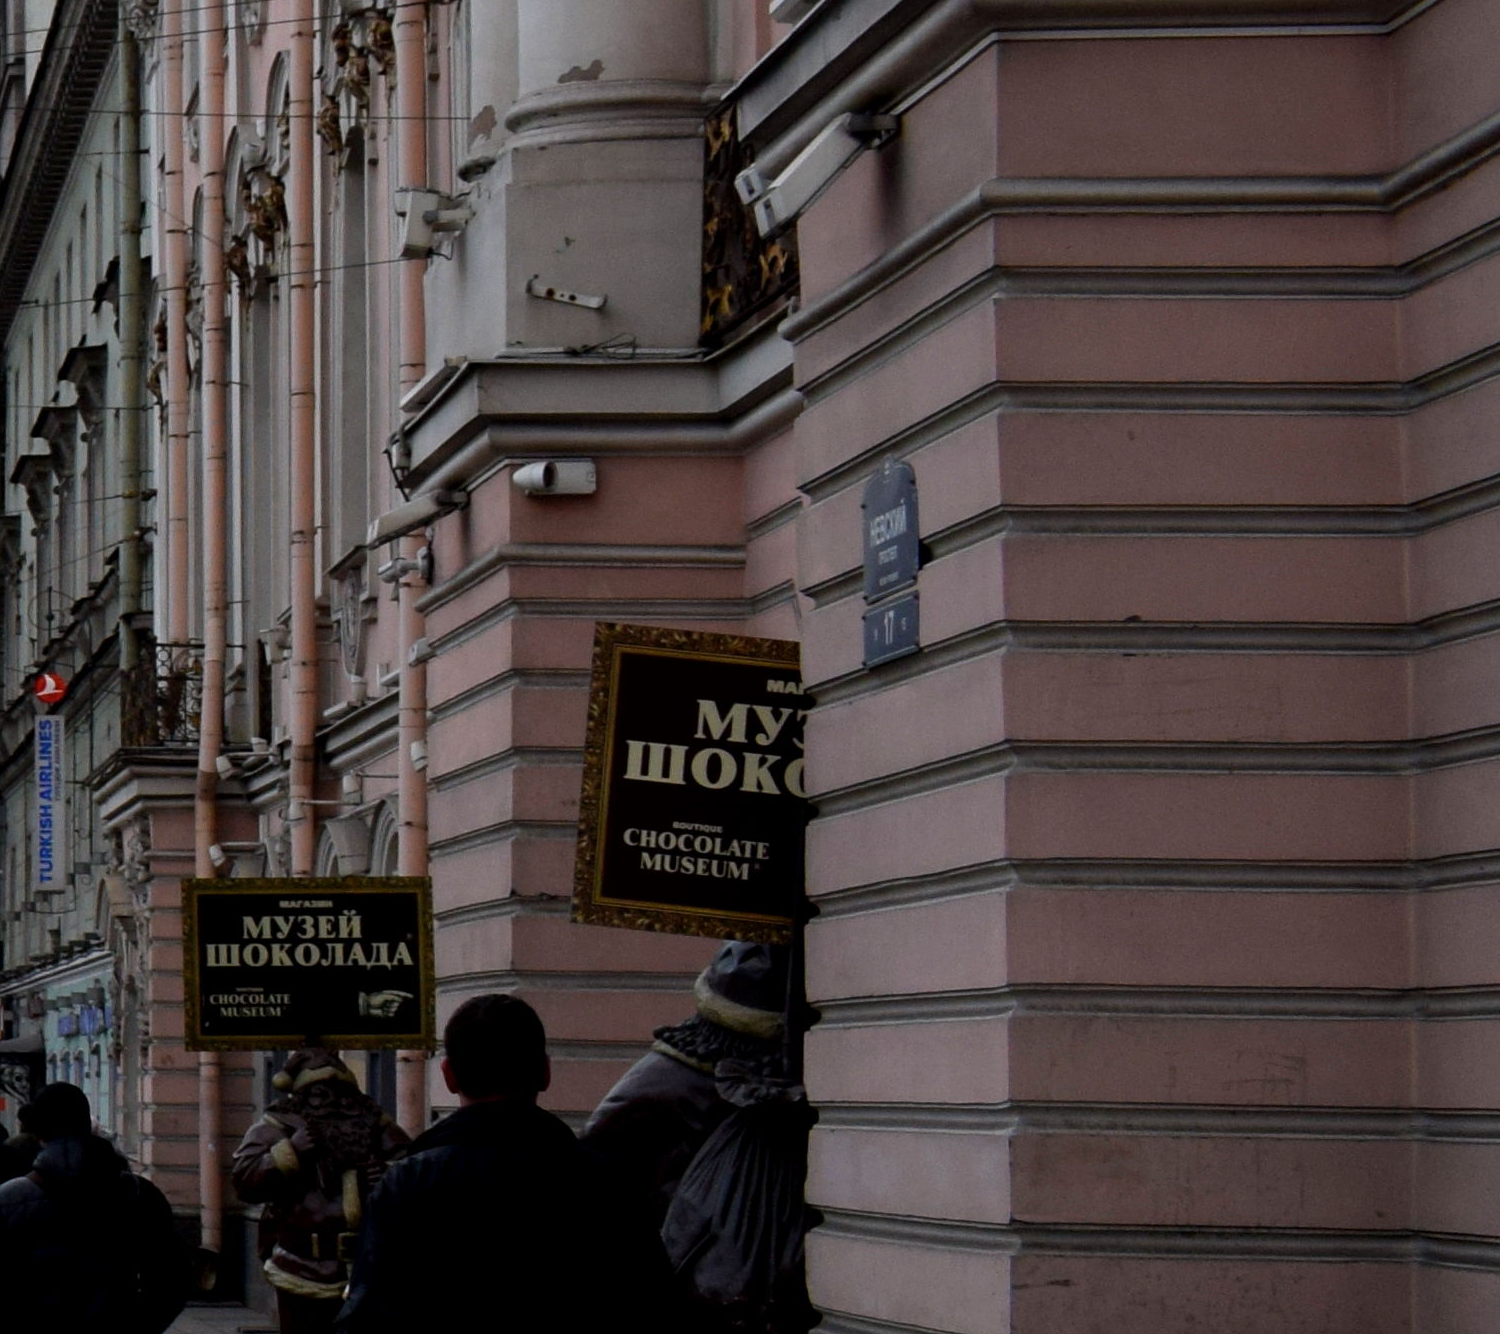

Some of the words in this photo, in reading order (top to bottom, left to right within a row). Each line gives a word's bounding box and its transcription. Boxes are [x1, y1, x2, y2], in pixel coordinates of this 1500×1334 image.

[869, 498, 907, 547] НЕВСКИЙ
[884, 609, 895, 645] 17
[38, 720, 52, 801] AIRLINES
[672, 821, 723, 833] BOUTIQUE
[38, 805, 52, 883] TURKISH
[622, 828, 770, 860] CHOCOLATE
[640, 852, 750, 881] MUSEUM
[242, 909, 363, 940] МУЗЕЙ
[206, 941, 414, 970] ШОКОЛАДА
[209, 994, 291, 1005] CHOCOLATE
[220, 1006, 282, 1017] MUSEUM
